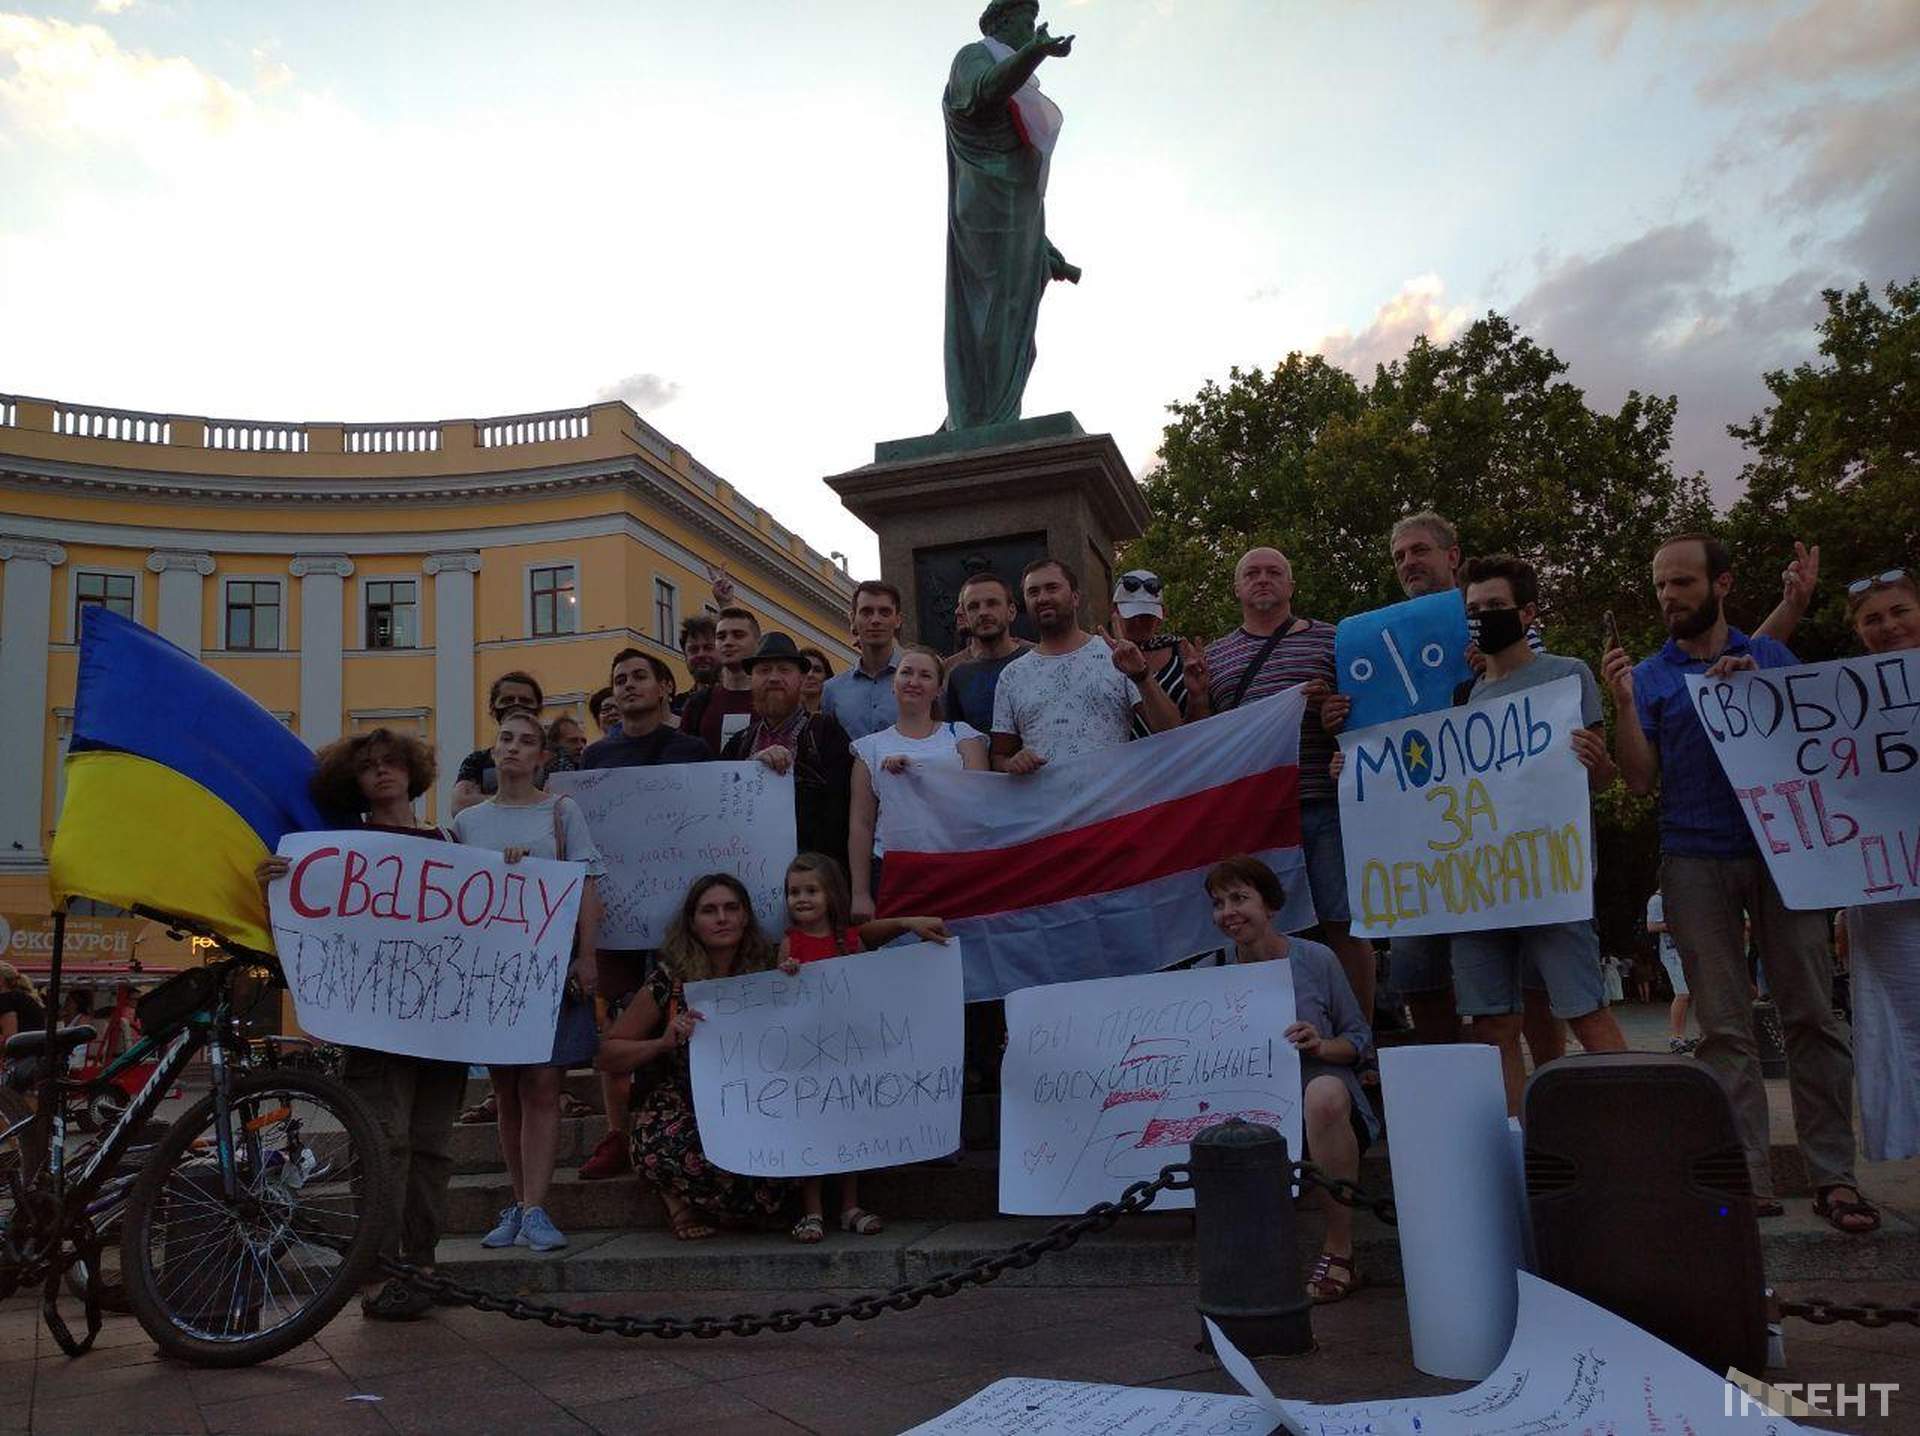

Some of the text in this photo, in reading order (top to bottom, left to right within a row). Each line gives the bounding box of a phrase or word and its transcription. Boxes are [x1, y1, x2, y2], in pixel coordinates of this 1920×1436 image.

[1356, 696, 1552, 802] МОЛОДЬ
[1426, 778, 1499, 852] ЗА
[1096, 1000, 1214, 1047] ПРОСТО
[748, 1147, 786, 1169] МЫ
[801, 1146, 820, 1167] С
